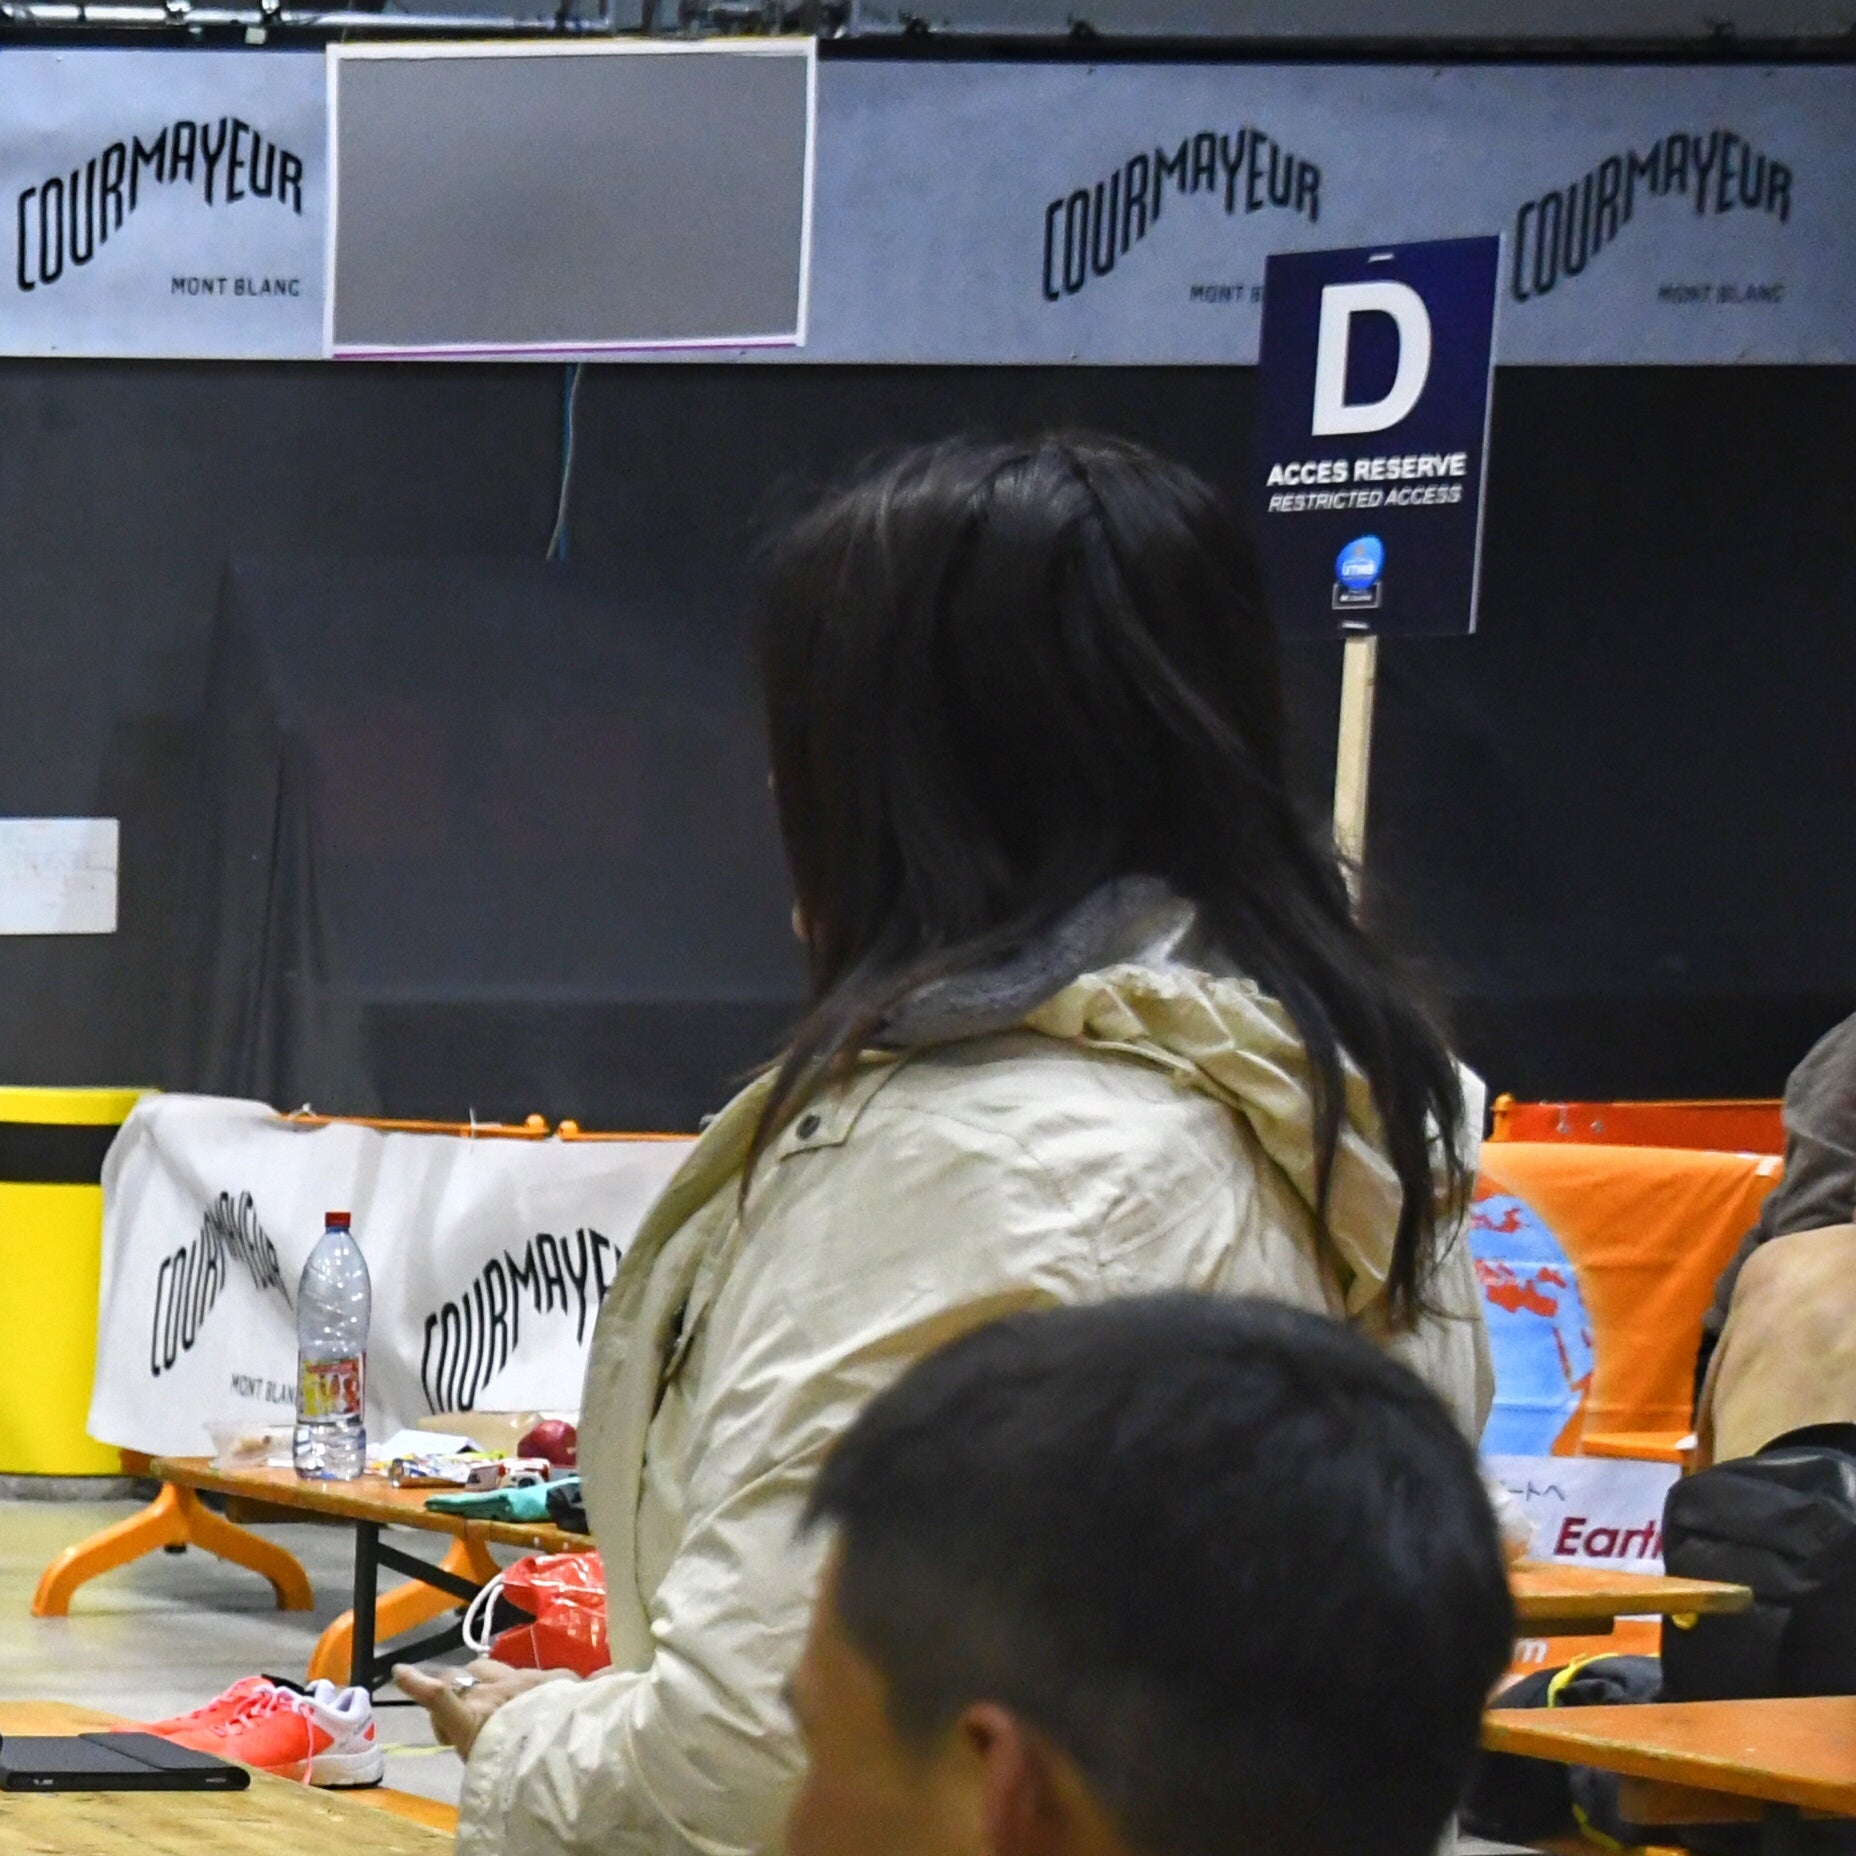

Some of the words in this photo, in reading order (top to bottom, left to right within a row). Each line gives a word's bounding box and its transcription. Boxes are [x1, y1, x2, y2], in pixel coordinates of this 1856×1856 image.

[15, 116, 304, 294] COURMAYEUR
[1041, 125, 1323, 304] COURMAYEUR
[1513, 126, 1793, 303] COURMAYEUR
[170, 275, 229, 296] MONT
[235, 276, 302, 299] BLANC
[1189, 283, 1246, 304] MONT
[1659, 283, 1715, 303] MONT
[1719, 283, 1785, 305] BLANC
[1312, 280, 1431, 436] D
[1266, 460, 1348, 487] ACCES
[1354, 452, 1467, 480] RESERVE
[1268, 488, 1383, 513] RESTRICTED
[1385, 484, 1463, 506] ACCESS
